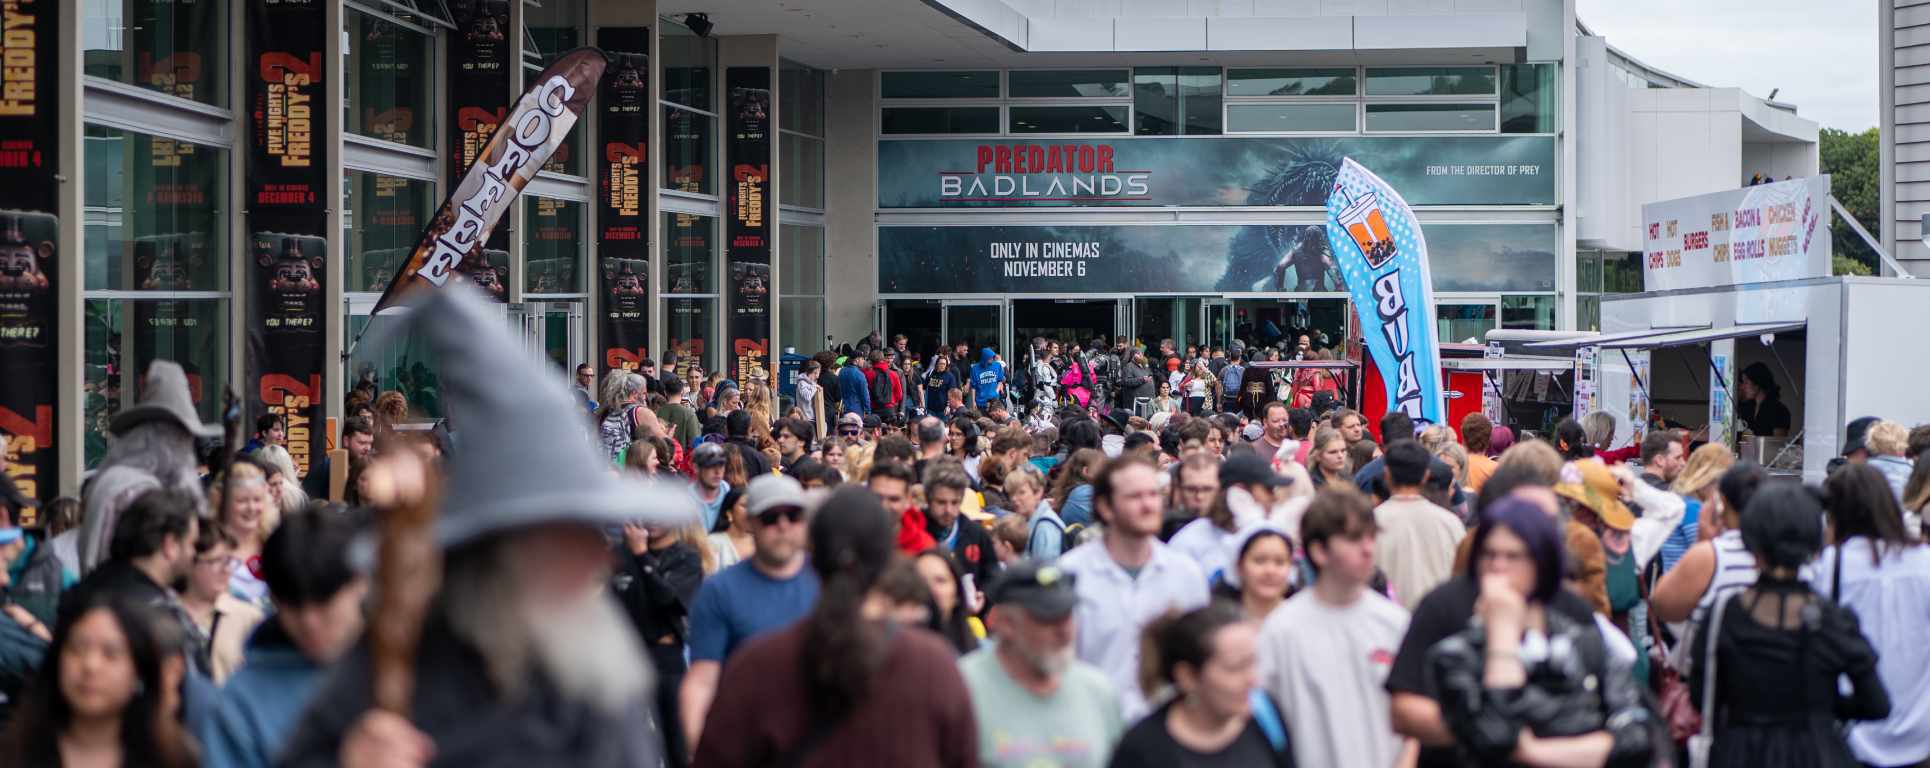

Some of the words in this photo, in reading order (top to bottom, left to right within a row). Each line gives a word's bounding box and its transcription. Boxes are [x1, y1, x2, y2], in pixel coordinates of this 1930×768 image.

[260, 51, 321, 82] 2
[268, 83, 285, 128] NIGHTS
[281, 73, 311, 167] FREDDY'S
[268, 130, 285, 154] FIVE
[607, 143, 646, 162] 2
[976, 144, 1114, 174] PREDATOR
[735, 165, 768, 182] 2
[1426, 165, 1448, 176] FROM
[1450, 165, 1465, 176] THE
[1467, 165, 1505, 176] DIRECTOR
[1507, 165, 1518, 176] OF
[1520, 165, 1540, 176] PREY
[416, 74, 576, 288] COFFEE
[620, 156, 639, 215] FREDDY'S
[941, 175, 1149, 196] BADLANDS
[307, 192, 315, 204] 4
[746, 175, 762, 226] FREDDY'S
[1735, 210, 1753, 229] BACON
[1648, 222, 1660, 241] HOT
[1665, 220, 1678, 239] HOT
[990, 242, 1021, 258] ONLY
[1026, 242, 1038, 258] IN
[1043, 242, 1099, 258] CINEMAS
[1684, 230, 1708, 251] BURGERS
[1734, 241, 1745, 261] EGG
[1747, 238, 1765, 259] ROLLS
[1004, 261, 1072, 276] NOVEMBER
[1077, 261, 1086, 276] 6
[1649, 251, 1664, 270] CHIPS
[266, 318, 280, 327] YOU
[285, 318, 313, 327] THERE?
[1, 326, 39, 339] THERE?
[735, 338, 768, 356] 2
[260, 373, 320, 405] 2
